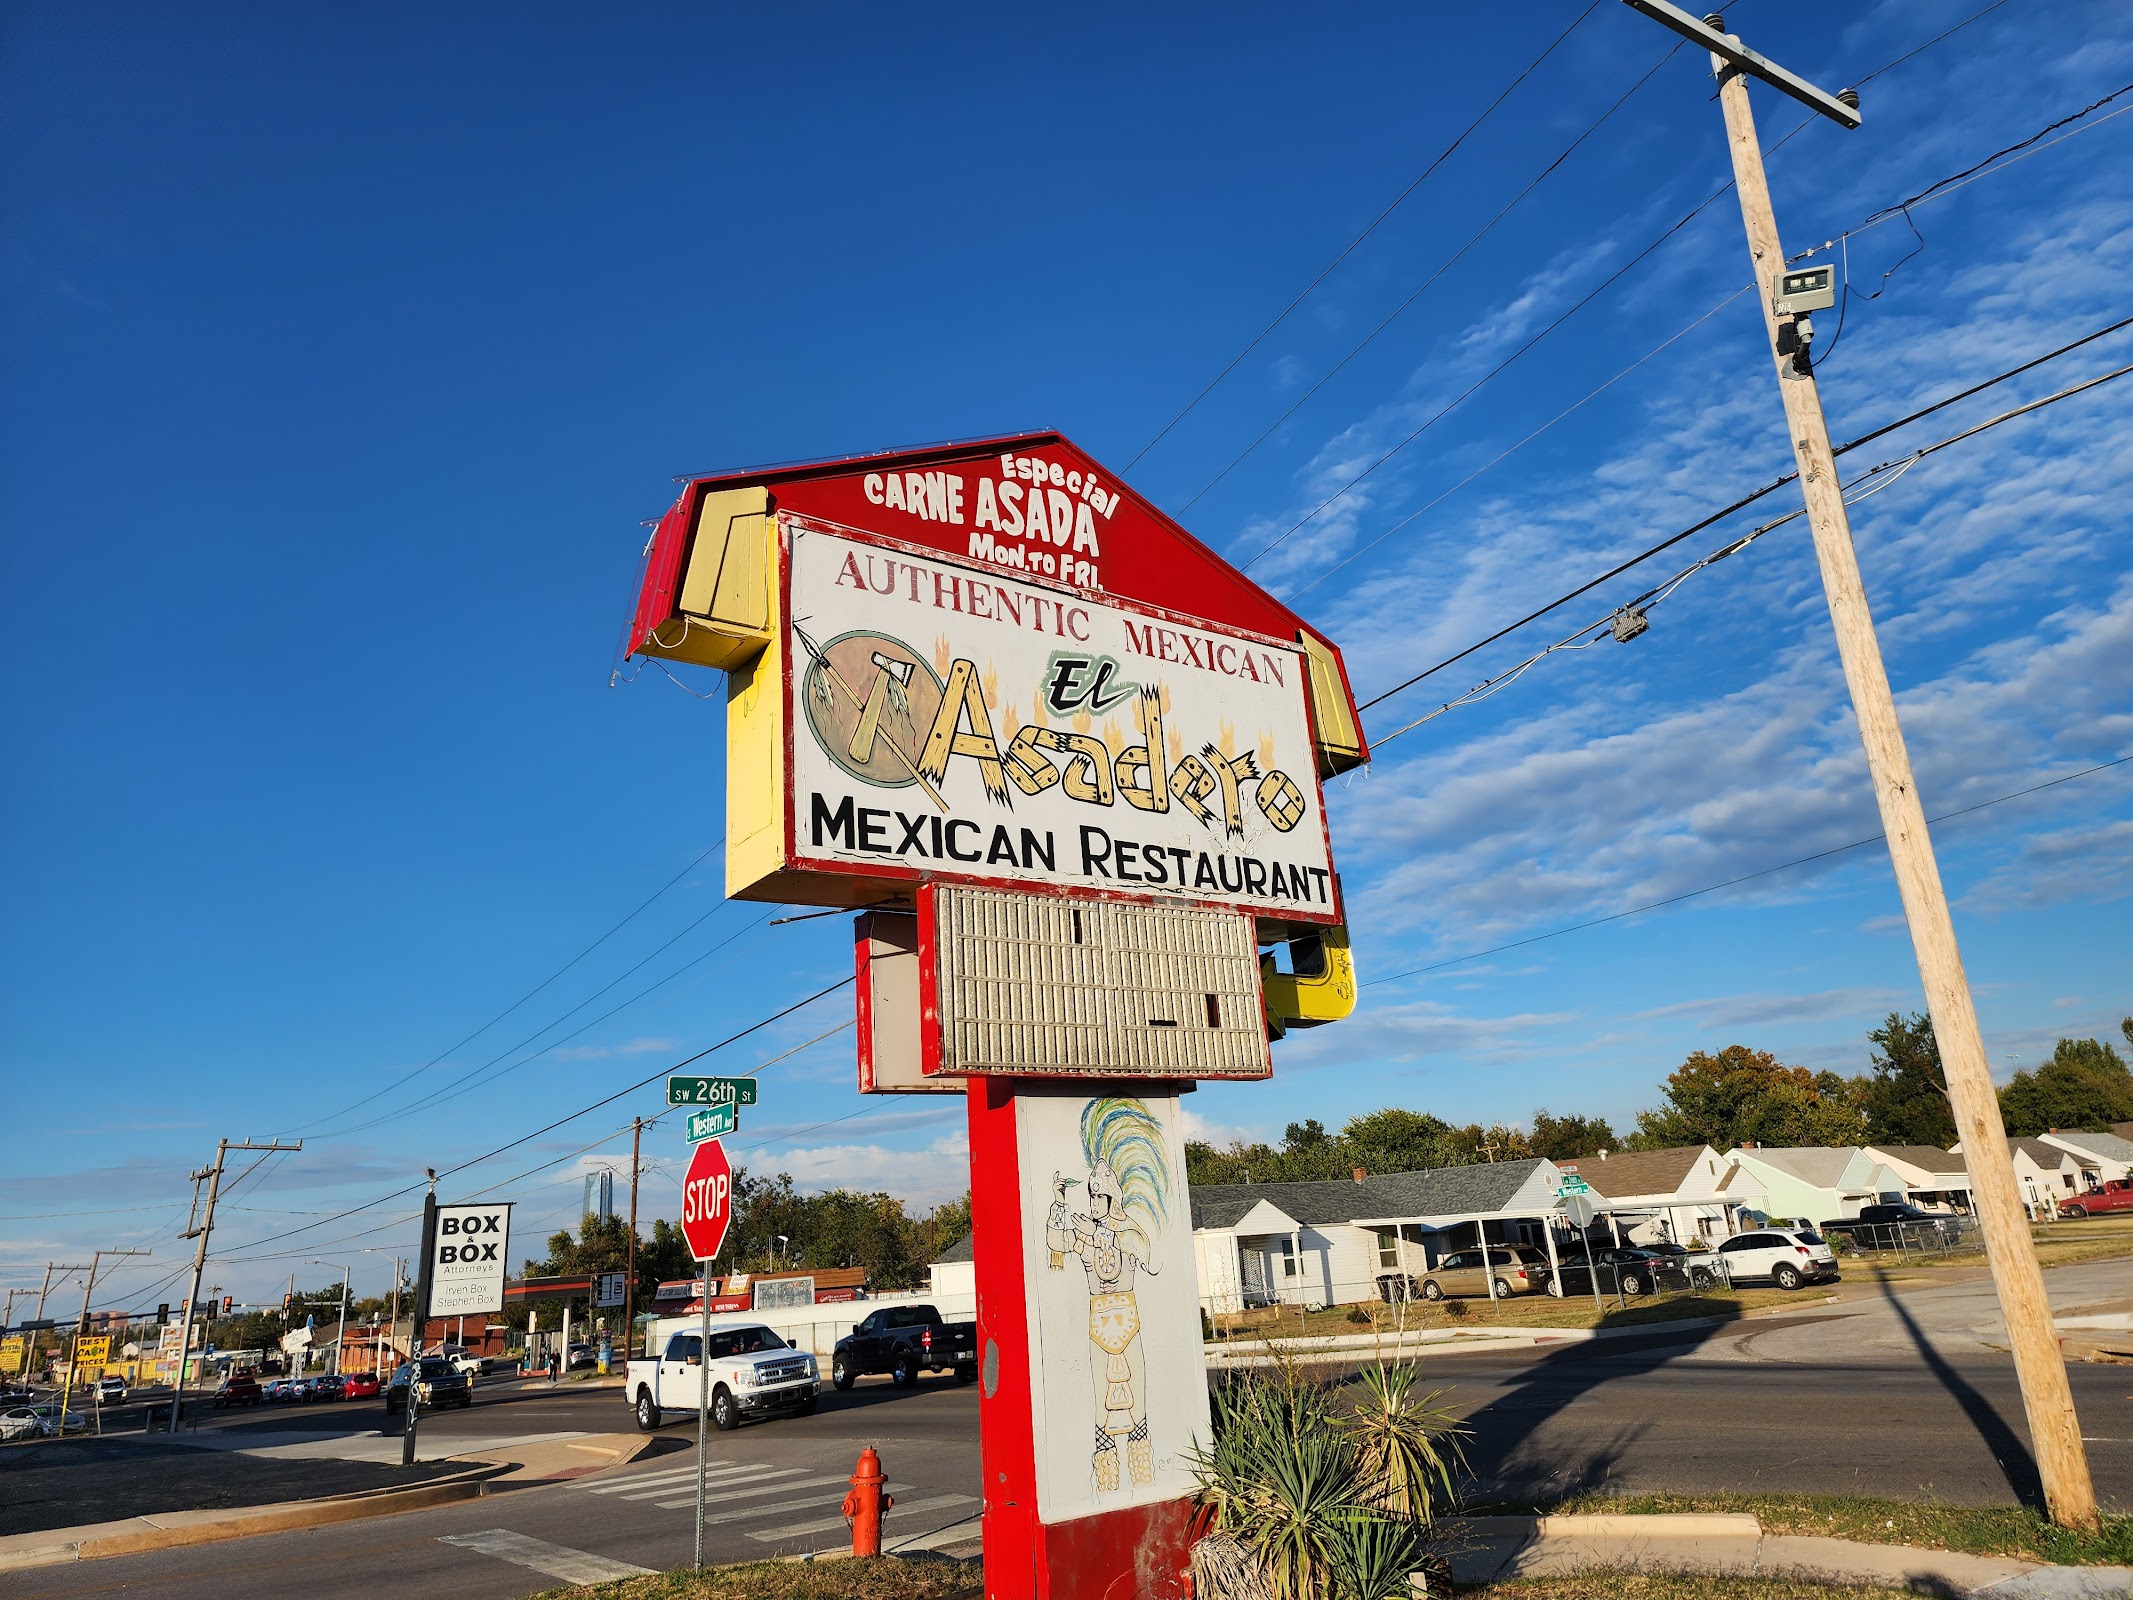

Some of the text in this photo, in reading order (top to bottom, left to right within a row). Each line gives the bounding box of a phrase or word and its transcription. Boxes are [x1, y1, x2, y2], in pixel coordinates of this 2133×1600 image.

[1001, 454, 1120, 520] Especial
[864, 471, 1099, 557] CARNE ASADA
[834, 550, 1286, 688] AUTHENTIC MEXICAN
[1049, 658, 1135, 711] El
[917, 658, 1306, 839] Asadero
[811, 792, 1329, 904] MEXICAN RESTAURANT
[675, 1080, 751, 1102] SW 26th St
[693, 1113, 723, 1137] Western
[724, 1119, 732, 1129] Ave
[685, 1174, 727, 1223] STOP
[442, 1215, 501, 1236] BOX
[440, 1243, 498, 1264] BOX
[444, 1264, 494, 1275] Attorneys
[438, 1294, 494, 1308] Stephen Box
[446, 1283, 487, 1295] Irven Box
[80, 1337, 106, 1346] BEST
